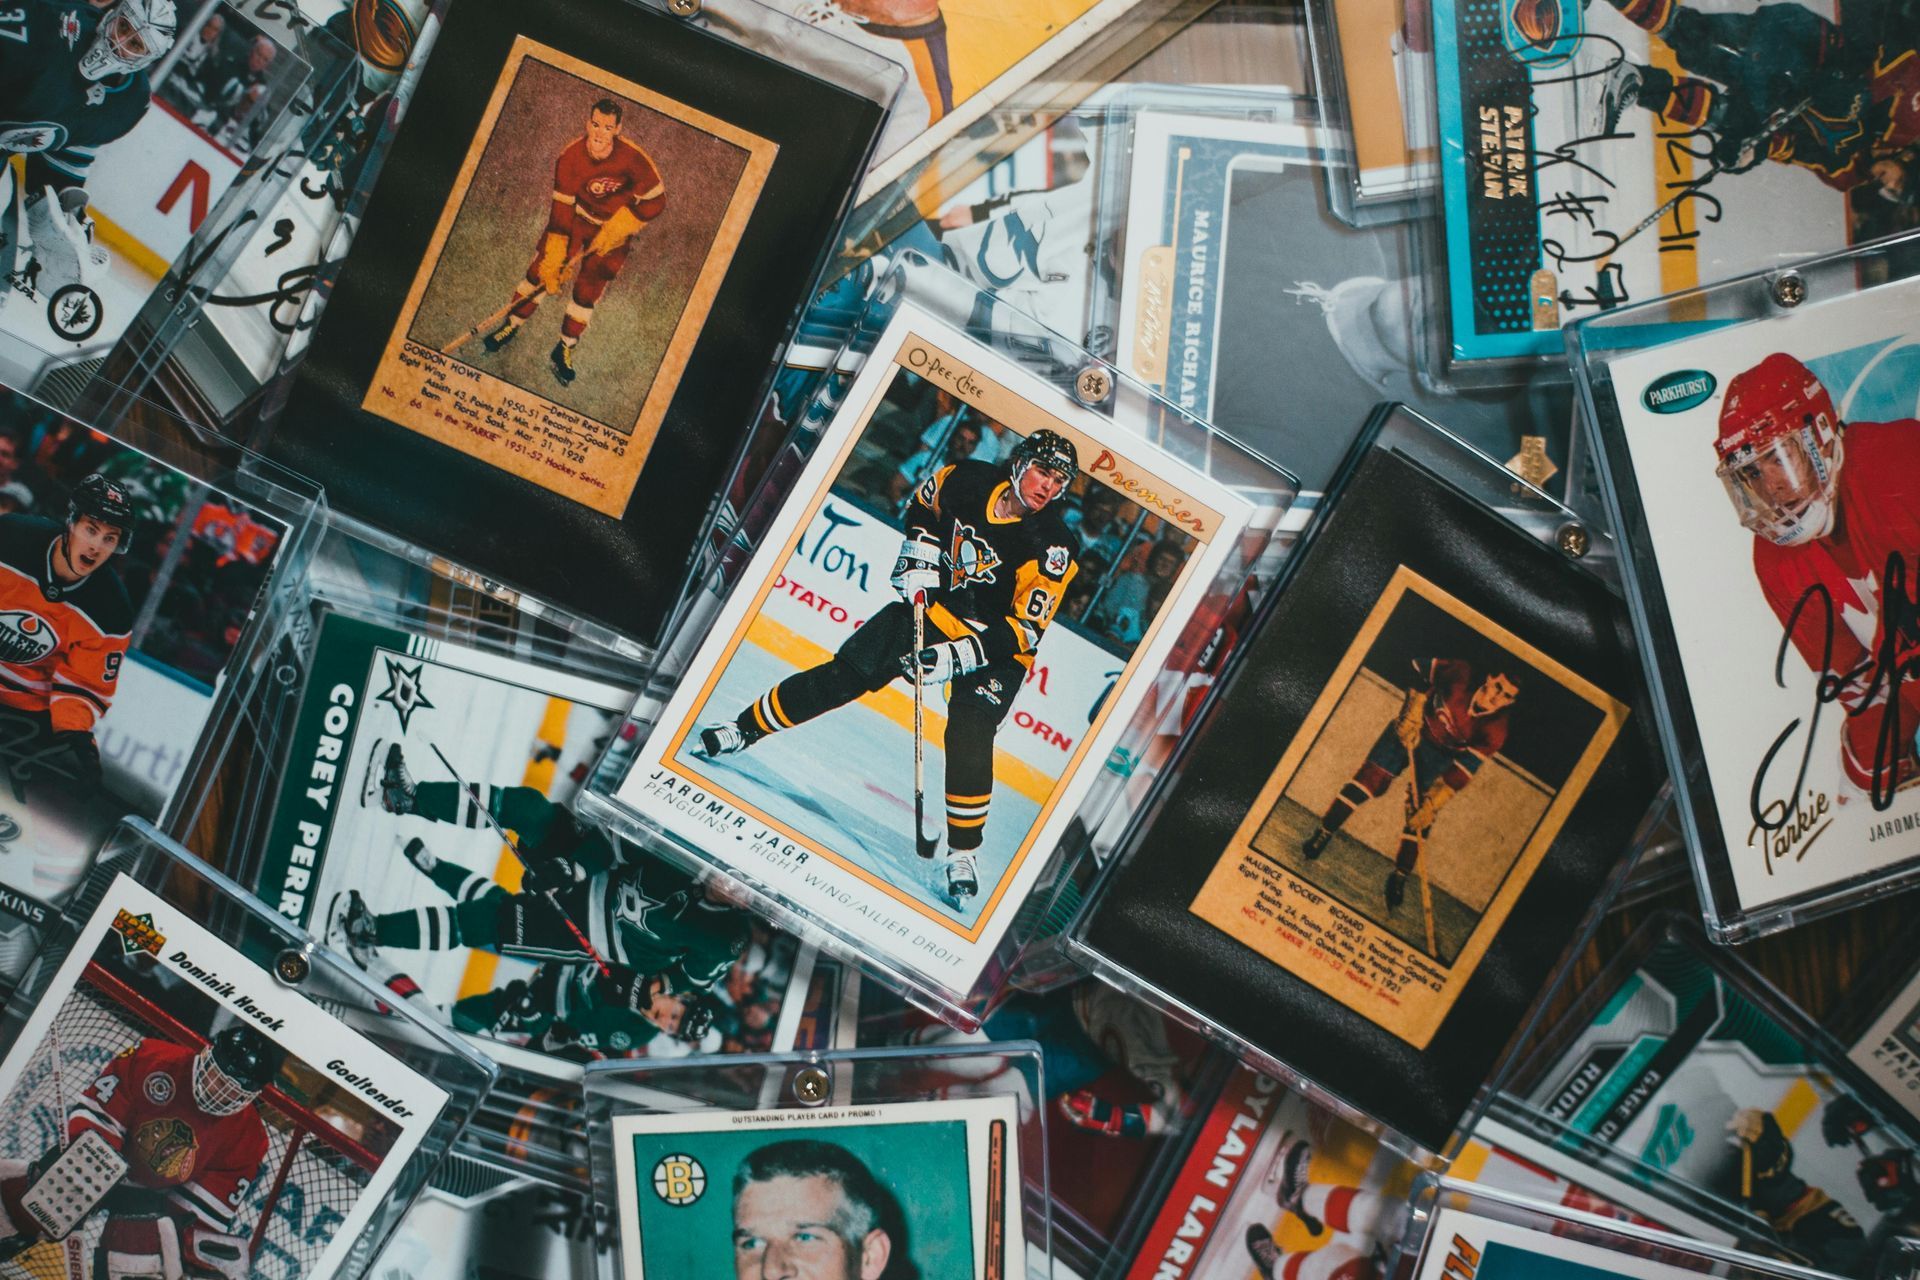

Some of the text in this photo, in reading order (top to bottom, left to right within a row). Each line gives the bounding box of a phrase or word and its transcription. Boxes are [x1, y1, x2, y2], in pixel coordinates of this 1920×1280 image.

[1187, 209, 1210, 315] MAURICE
[399, 352, 421, 368] Right
[502, 397, 539, 419] 1950-51
[612, 445, 625, 457] 43
[403, 342, 447, 366] GORDON
[450, 363, 482, 382] HOWE
[582, 420, 599, 433] Red
[603, 428, 629, 446] Wings
[424, 378, 451, 394] Assists
[469, 396, 494, 413] Points
[533, 424, 541, 433] in
[543, 427, 573, 449] Penalty
[575, 442, 589, 453] 74
[1649, 377, 1709, 406] PARKHURST
[409, 398, 422, 409] 66
[444, 414, 459, 426] the
[504, 439, 543, 462] 1951-52
[545, 456, 576, 478] Hockey
[561, 447, 585, 464] 1928
[1089, 449, 1205, 534] Premier
[277, 683, 355, 928] COREY PERR
[650, 770, 810, 865] JAROMIR JAGR
[643, 781, 731, 835] PENGUINS
[749, 841, 802, 875] RIGHT
[912, 934, 967, 967] DROIT
[1238, 863, 1259, 880] Right
[1332, 920, 1366, 945] 1950-51
[1243, 855, 1282, 882] MAURICE
[1328, 905, 1364, 931] RICHARD
[168, 951, 285, 1032] Dominik Hasek
[1381, 976, 1402, 994] 1921
[325, 1058, 414, 1120] Goaltender
[732, 1114, 785, 1124] OUTSTANDING
[787, 1112, 817, 1121] PLAYER
[818, 1110, 839, 1120] CARD
[848, 1109, 876, 1118] PROMO
